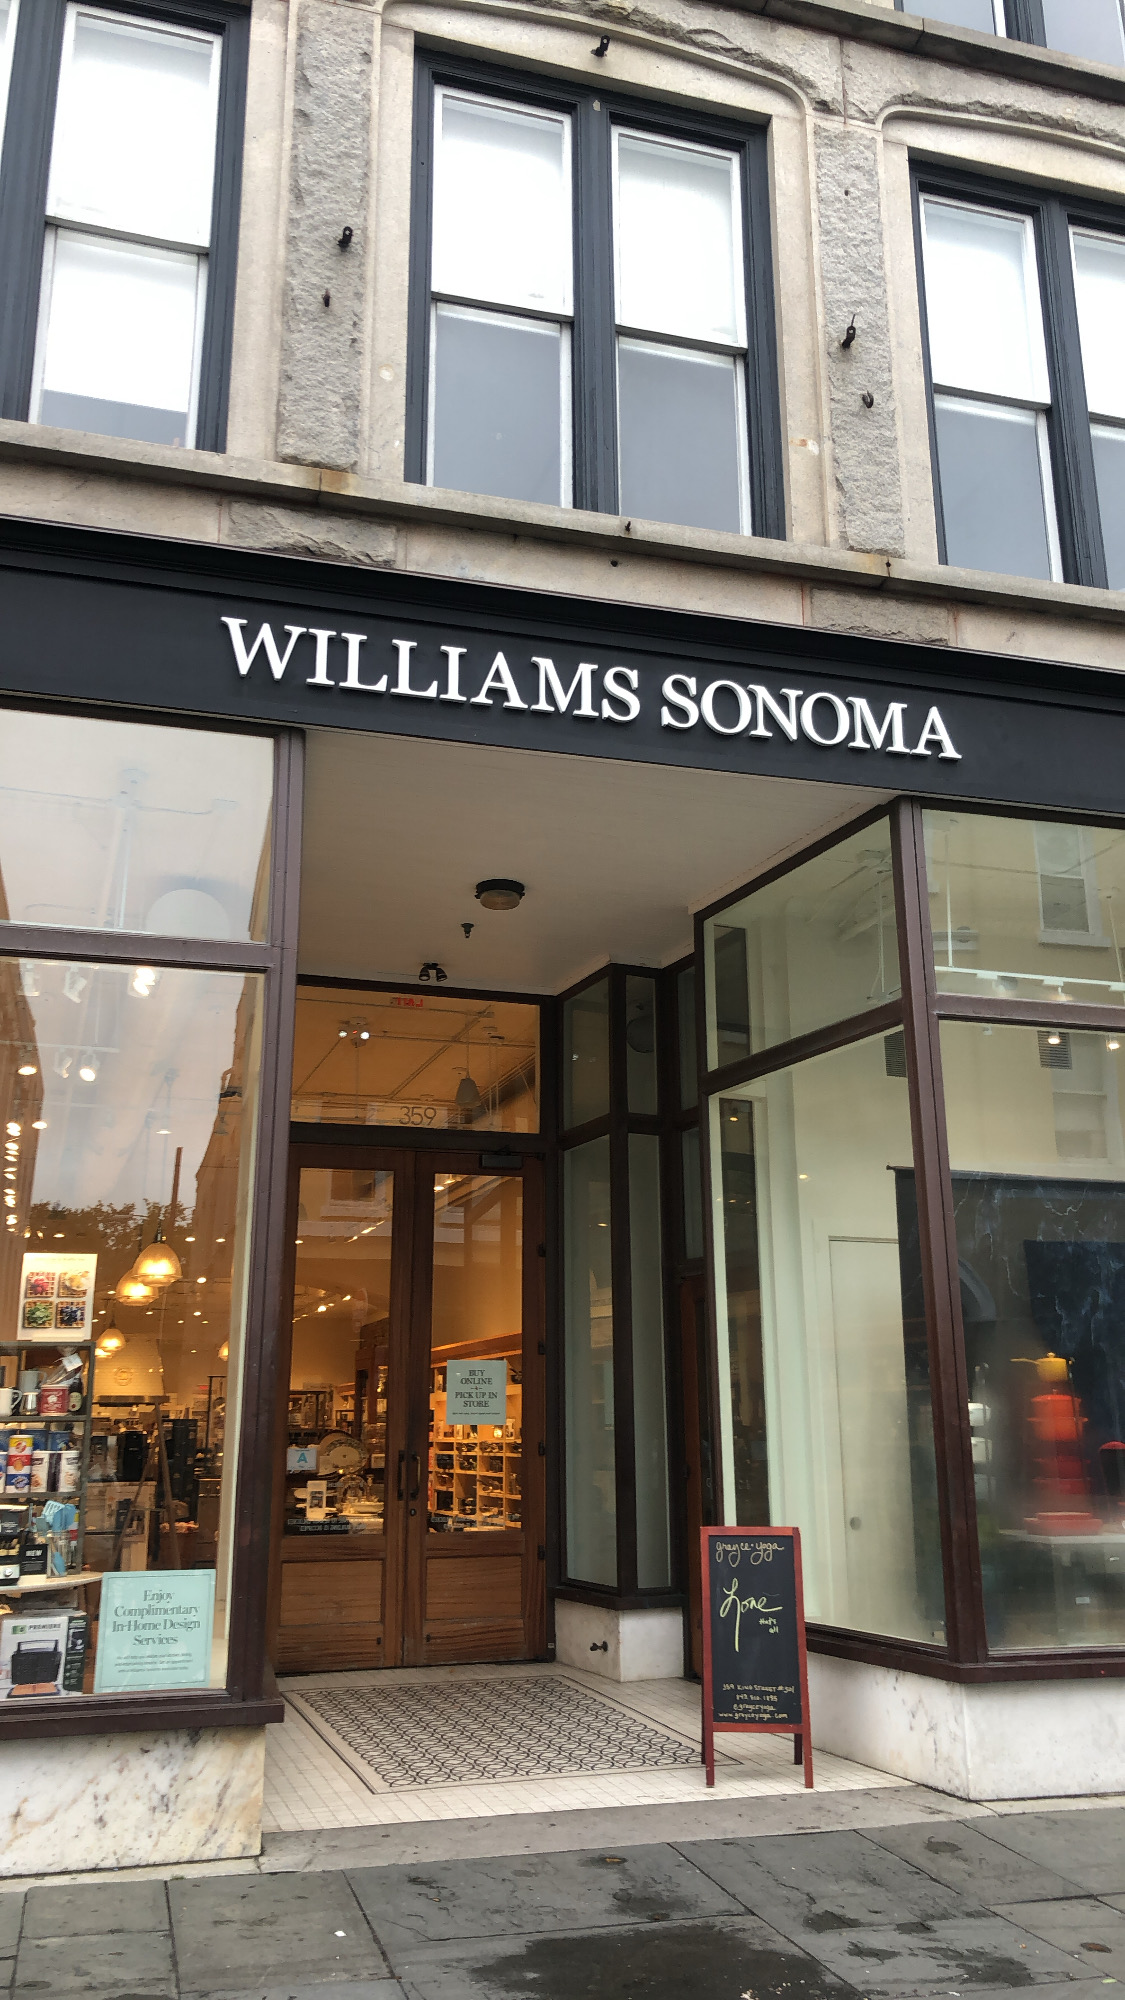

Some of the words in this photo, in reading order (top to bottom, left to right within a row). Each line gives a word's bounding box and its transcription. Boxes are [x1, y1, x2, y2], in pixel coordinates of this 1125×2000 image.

[220, 616, 641, 722] WILLIAMS
[660, 674, 963, 761] SONOMA
[399, 1106, 437, 1126] 359
[468, 1369, 485, 1377] BUY
[460, 1377, 493, 1385] ONLINE
[454, 1391, 474, 1399] PICK
[475, 1391, 487, 1399] UP
[488, 1391, 498, 1399] IN
[463, 1400, 490, 1408] STORE
[296, 1452, 308, 1463] A
[143, 1589, 175, 1604] Enjoy
[114, 1604, 200, 1620] Complimentary
[112, 1619, 161, 1633] In-Home
[163, 1617, 201, 1632] Design
[132, 1633, 179, 1646] Services
